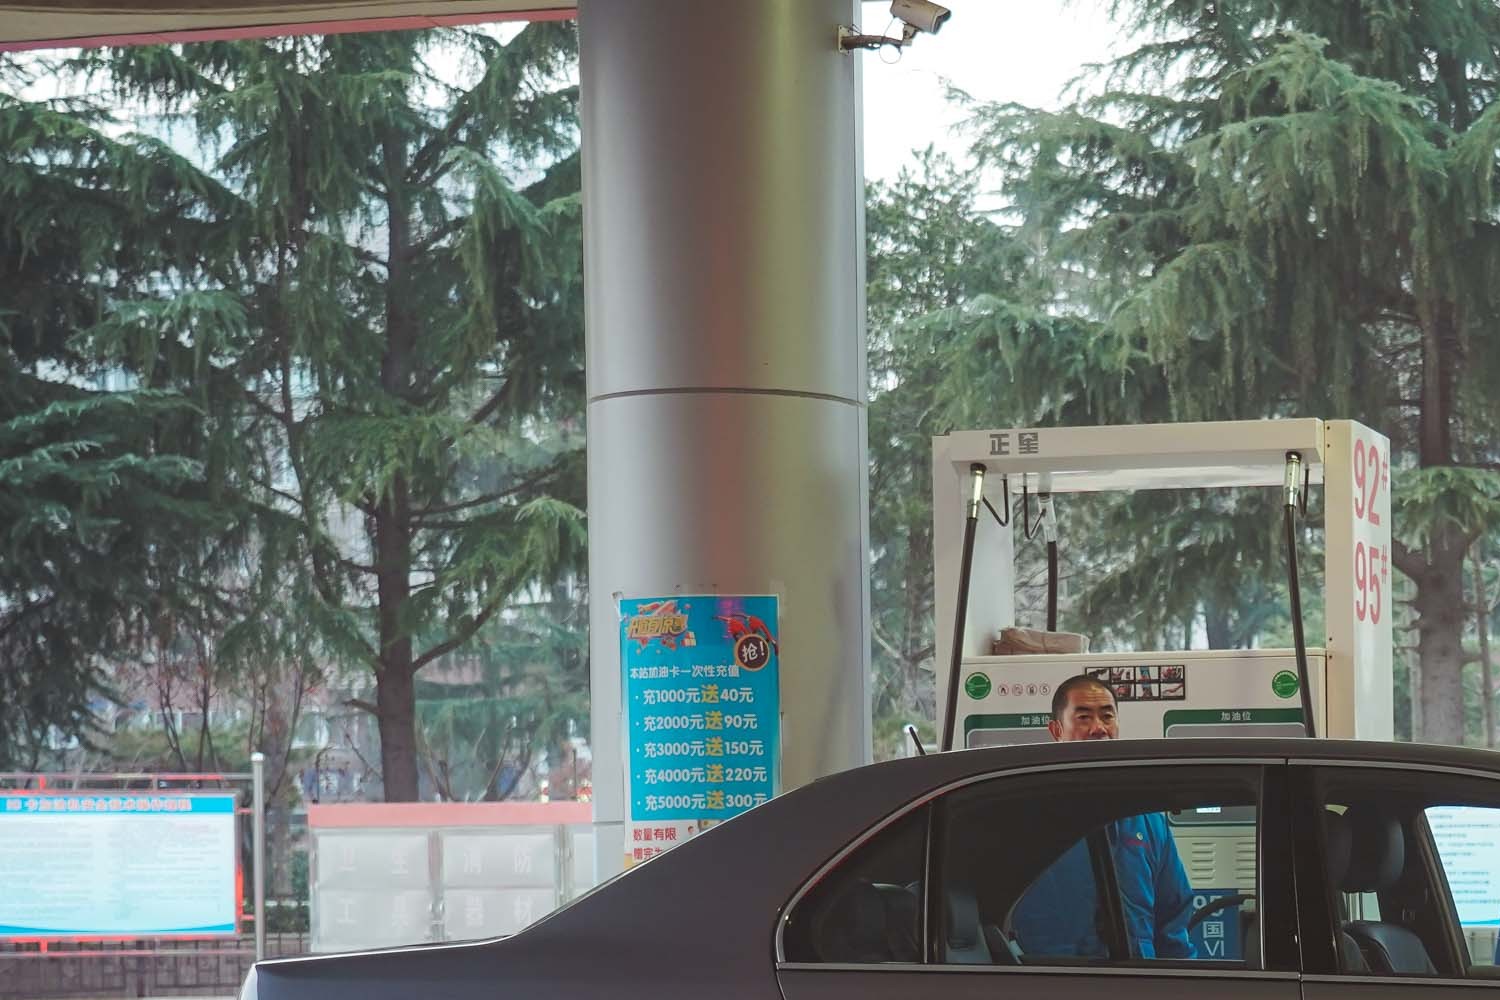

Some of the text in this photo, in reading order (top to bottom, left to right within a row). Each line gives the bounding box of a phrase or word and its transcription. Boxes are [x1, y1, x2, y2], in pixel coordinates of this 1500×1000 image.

[989, 432, 1039, 456] 正星
[630, 664, 740, 679] 本站加油卡一次性充值
[642, 684, 755, 706] 充1000元送40元
[643, 711, 758, 732] 充2000元送90元
[1021, 714, 1050, 726] 加油位
[1221, 711, 1252, 722] 加油位
[643, 737, 765, 758] 充3000元送150元
[644, 763, 768, 785] 充4000元送220元
[633, 827, 677, 841] 数量有限
[1202, 921, 1225, 938] 国
